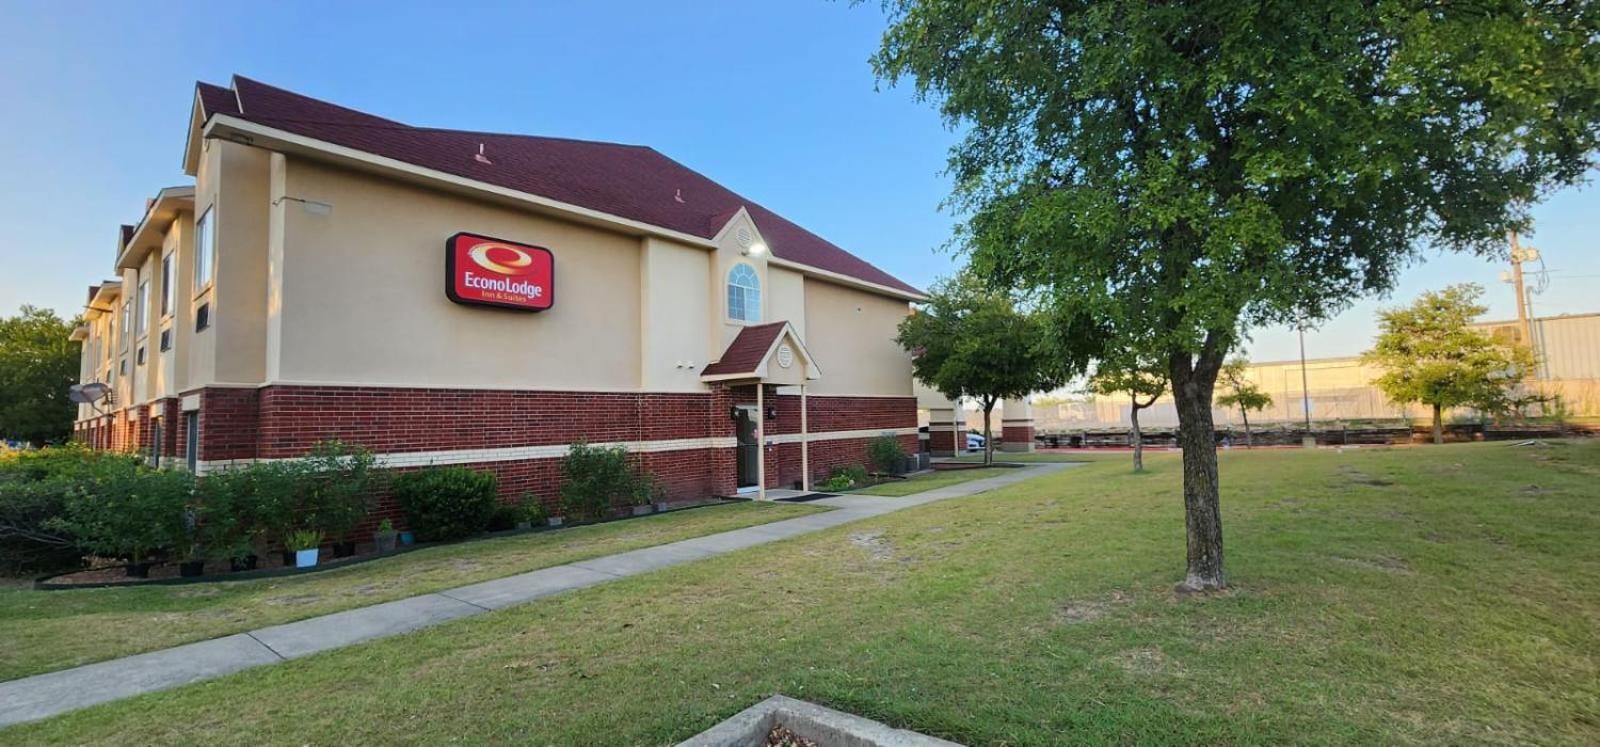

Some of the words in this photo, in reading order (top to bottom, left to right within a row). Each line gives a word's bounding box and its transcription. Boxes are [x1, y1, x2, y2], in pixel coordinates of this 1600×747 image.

[465, 271, 542, 298] EconoLodge
[481, 290, 495, 299] Inn
[503, 293, 527, 303] Suites
